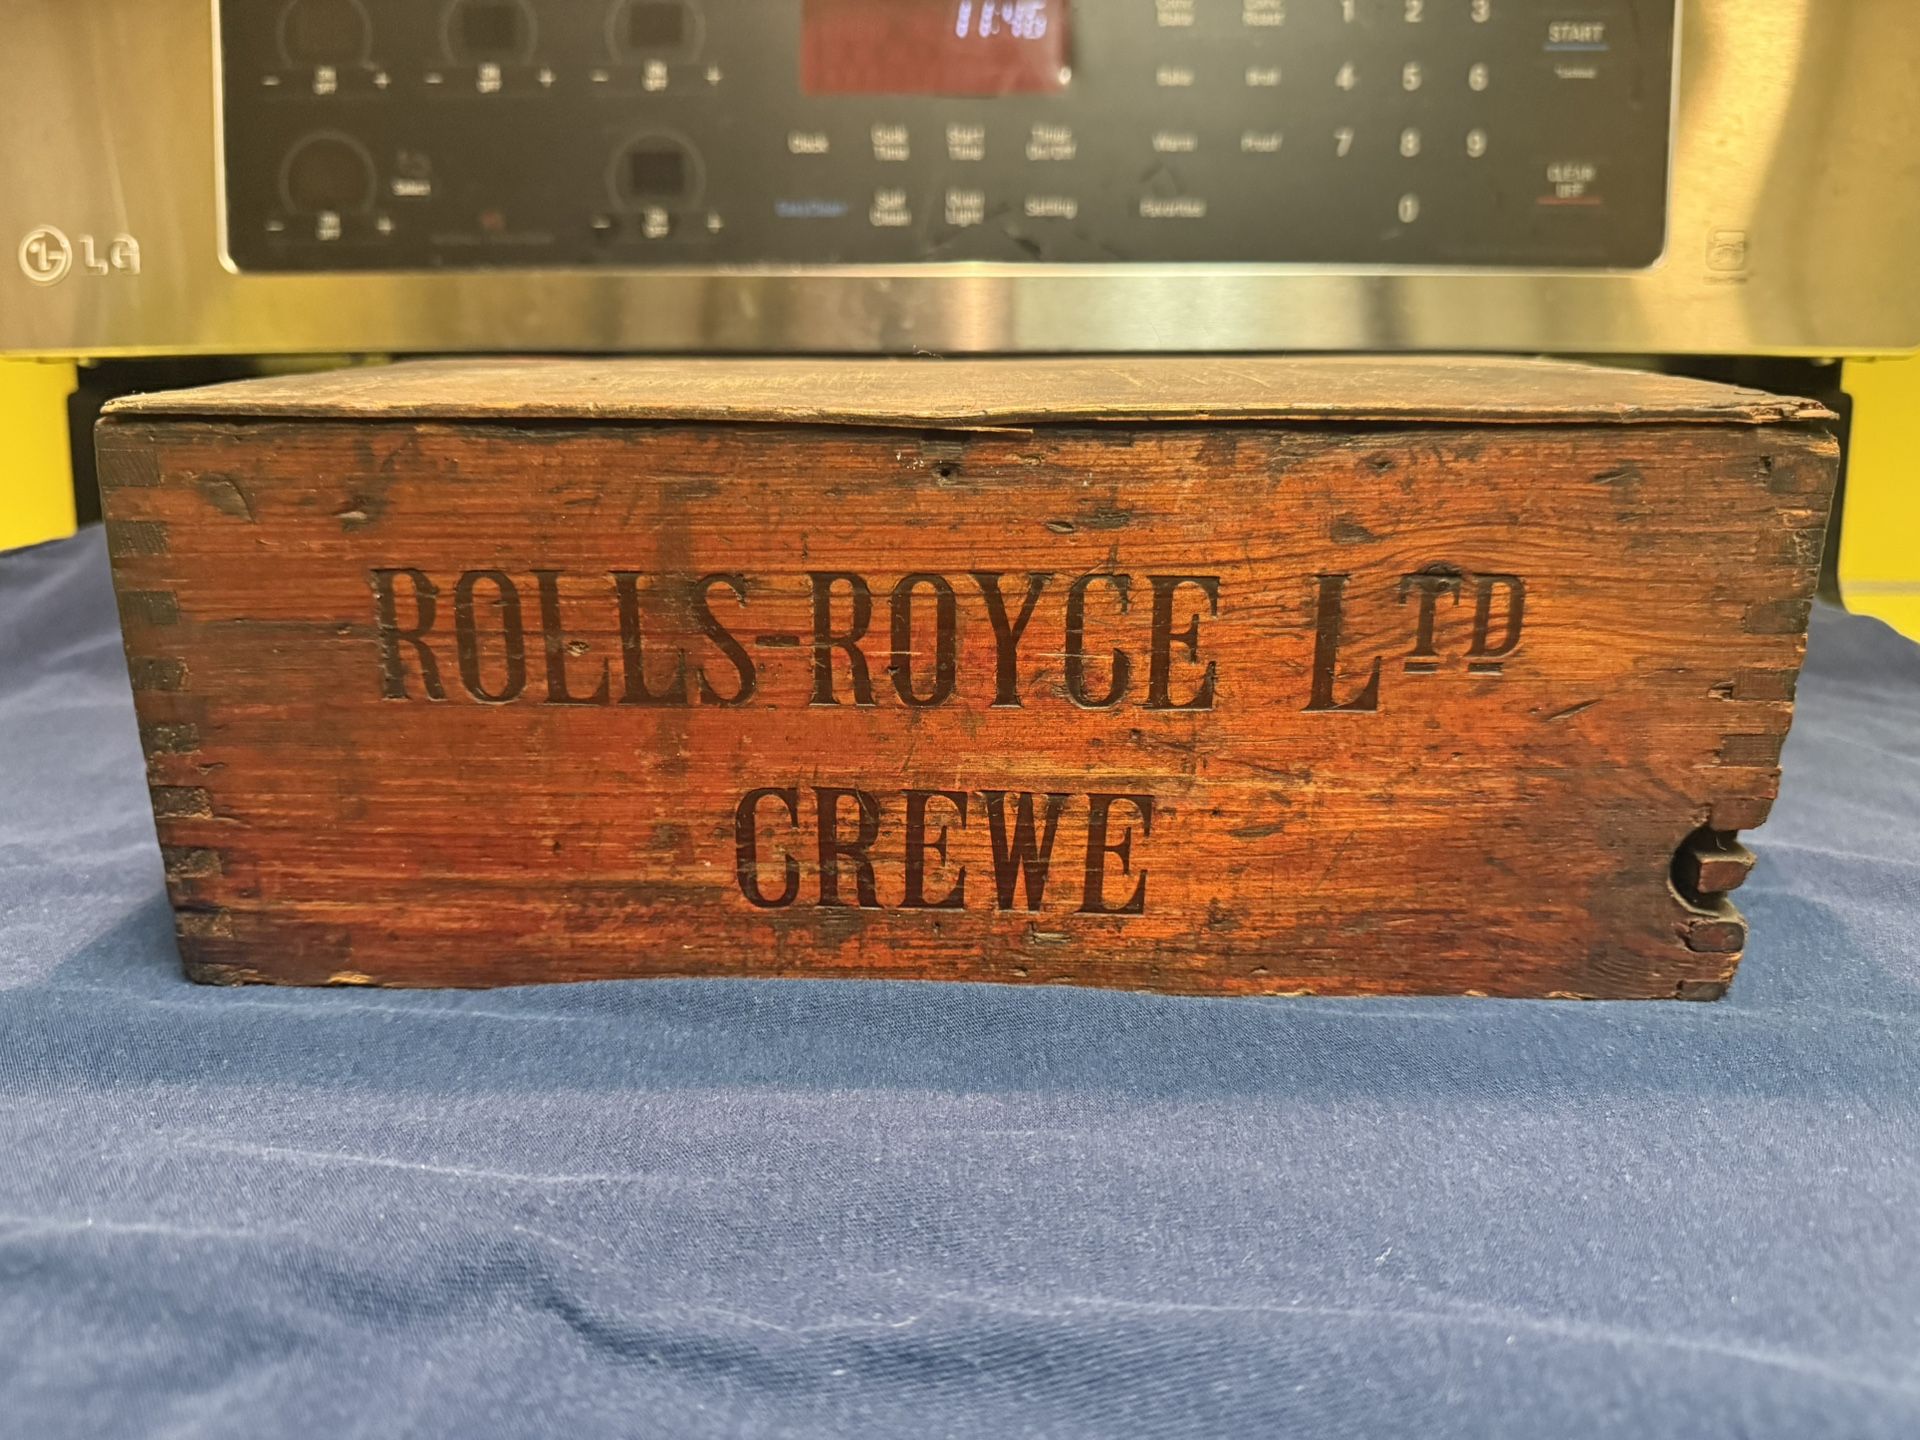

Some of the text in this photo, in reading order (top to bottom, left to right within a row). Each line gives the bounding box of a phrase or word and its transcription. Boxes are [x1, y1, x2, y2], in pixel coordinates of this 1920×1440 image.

[1341, 0, 1490, 23] 1 2 3
[1548, 23, 1604, 42] START
[1335, 61, 1488, 91] 4 5 6
[1334, 128, 1487, 157] 7 8 9
[78, 232, 141, 276] LG
[370, 567, 1221, 712] ROLLS-ROYCE
[734, 784, 1155, 916] CREWE
